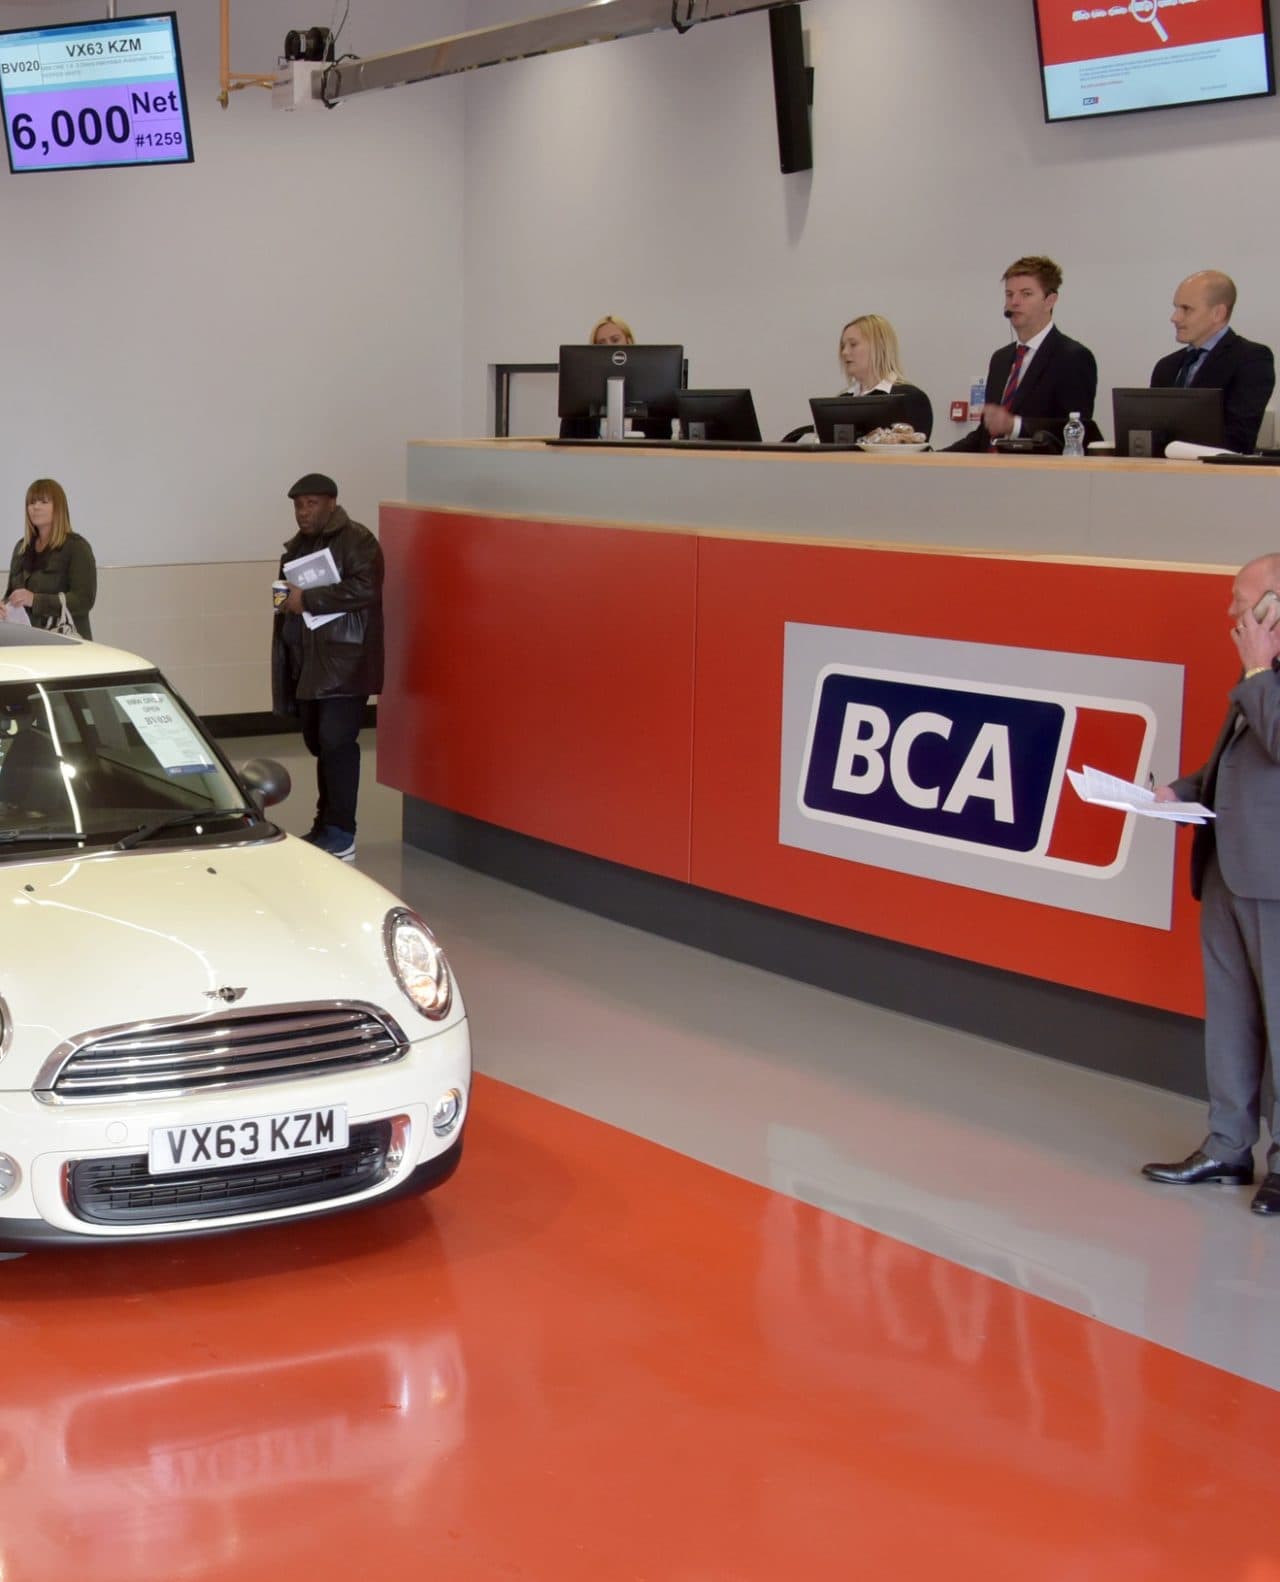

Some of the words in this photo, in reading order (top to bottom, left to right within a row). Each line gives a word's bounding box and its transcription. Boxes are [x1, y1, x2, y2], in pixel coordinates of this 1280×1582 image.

[66, 42, 104, 57] VX63
[108, 38, 142, 54] KZM
[1, 60, 40, 74] BV020
[131, 90, 179, 115] Net
[11, 105, 131, 156] 6,000
[135, 131, 183, 148] #1259
[832, 702, 1015, 825] BCA
[167, 1121, 260, 1164] VX63
[270, 1110, 334, 1152] KZM
